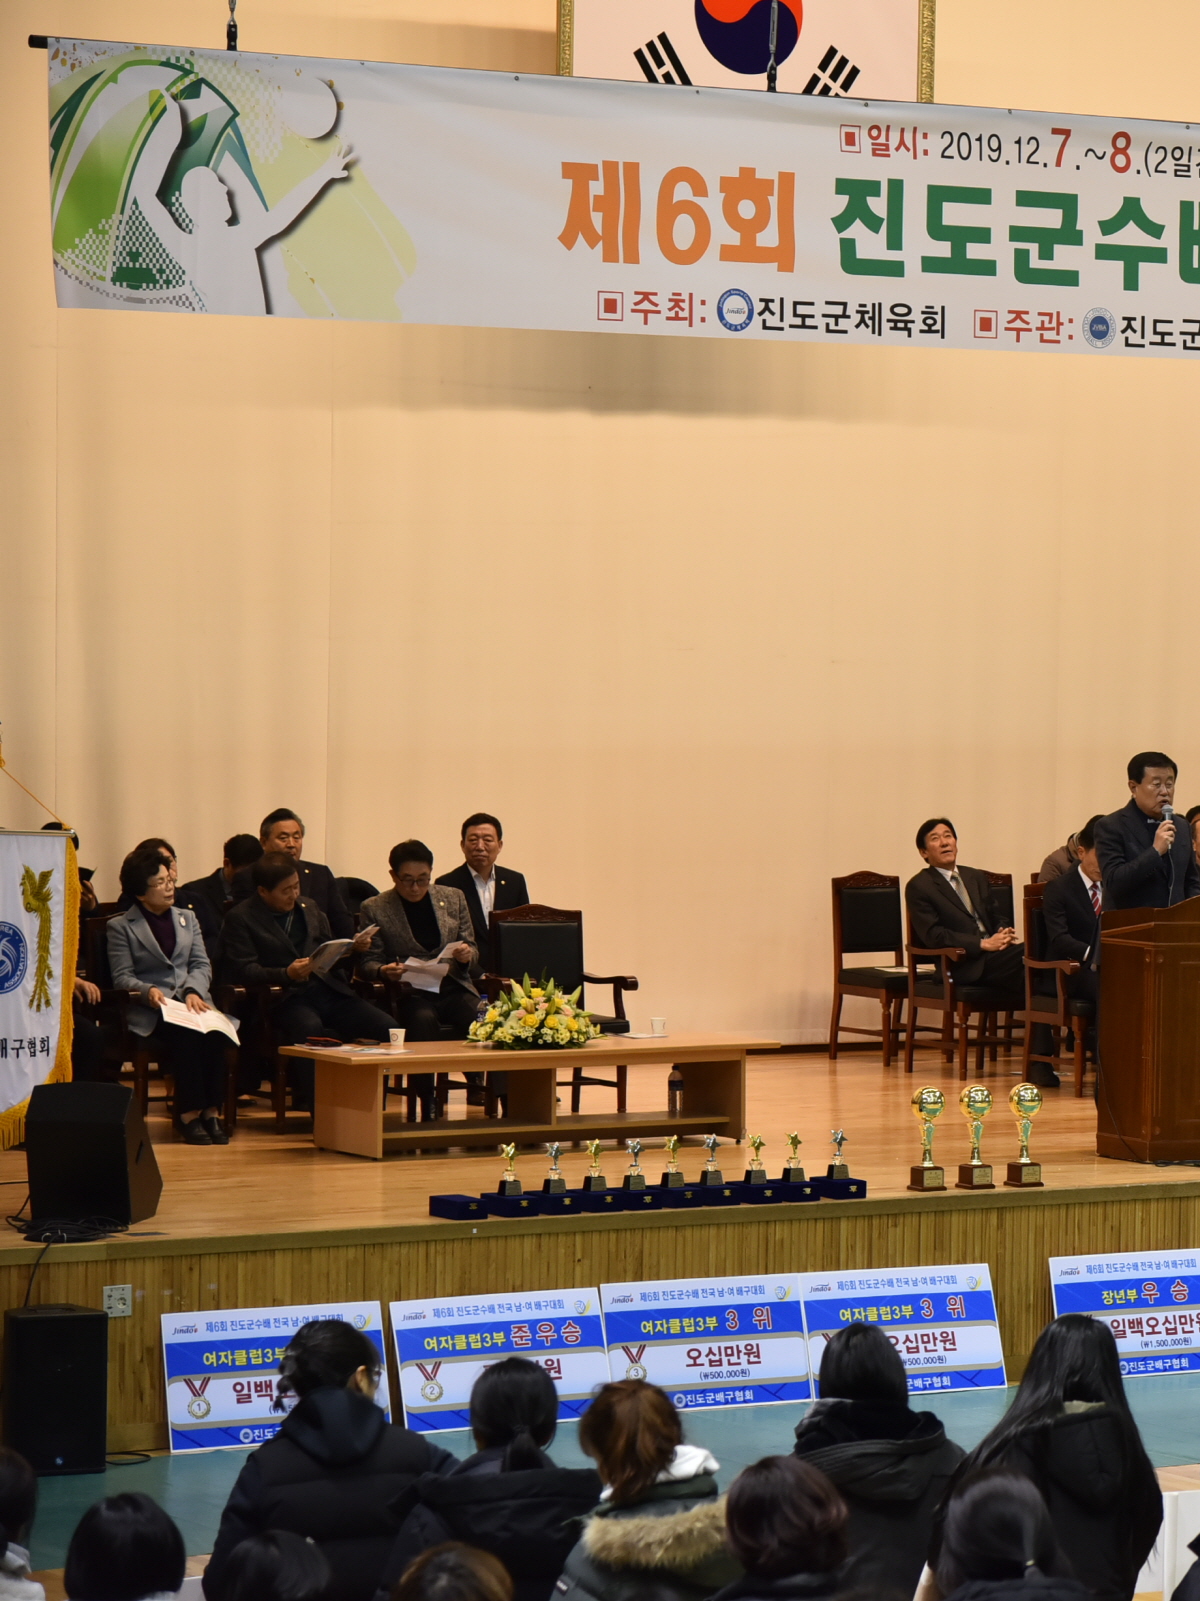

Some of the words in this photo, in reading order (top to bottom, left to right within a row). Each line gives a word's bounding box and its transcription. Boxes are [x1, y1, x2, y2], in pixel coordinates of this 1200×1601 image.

[868, 124, 929, 160] 일시:
[557, 160, 795, 273] 제6회
[630, 291, 707, 327] 주최:
[757, 297, 946, 339] 진도군체육회
[1004, 309, 1074, 344] 주관:
[1059, 1267, 1077, 1276] Jindo
[809, 1284, 828, 1293] Jindo
[610, 1295, 629, 1304] Jindo
[1101, 1289, 1138, 1305] 장년부
[401, 1312, 422, 1321] Jindo
[839, 1304, 914, 1322] 여자클럽3부
[172, 1324, 194, 1335] Jindo
[641, 1316, 718, 1335] 여자클럽3부
[424, 1332, 506, 1351] 여자클럽3부
[685, 1343, 762, 1367] 오십만원
[1128, 1357, 1189, 1372] 진도군배구협회
[906, 1376, 951, 1390] 군배구협회
[686, 1390, 753, 1405] 진도군배구협회
